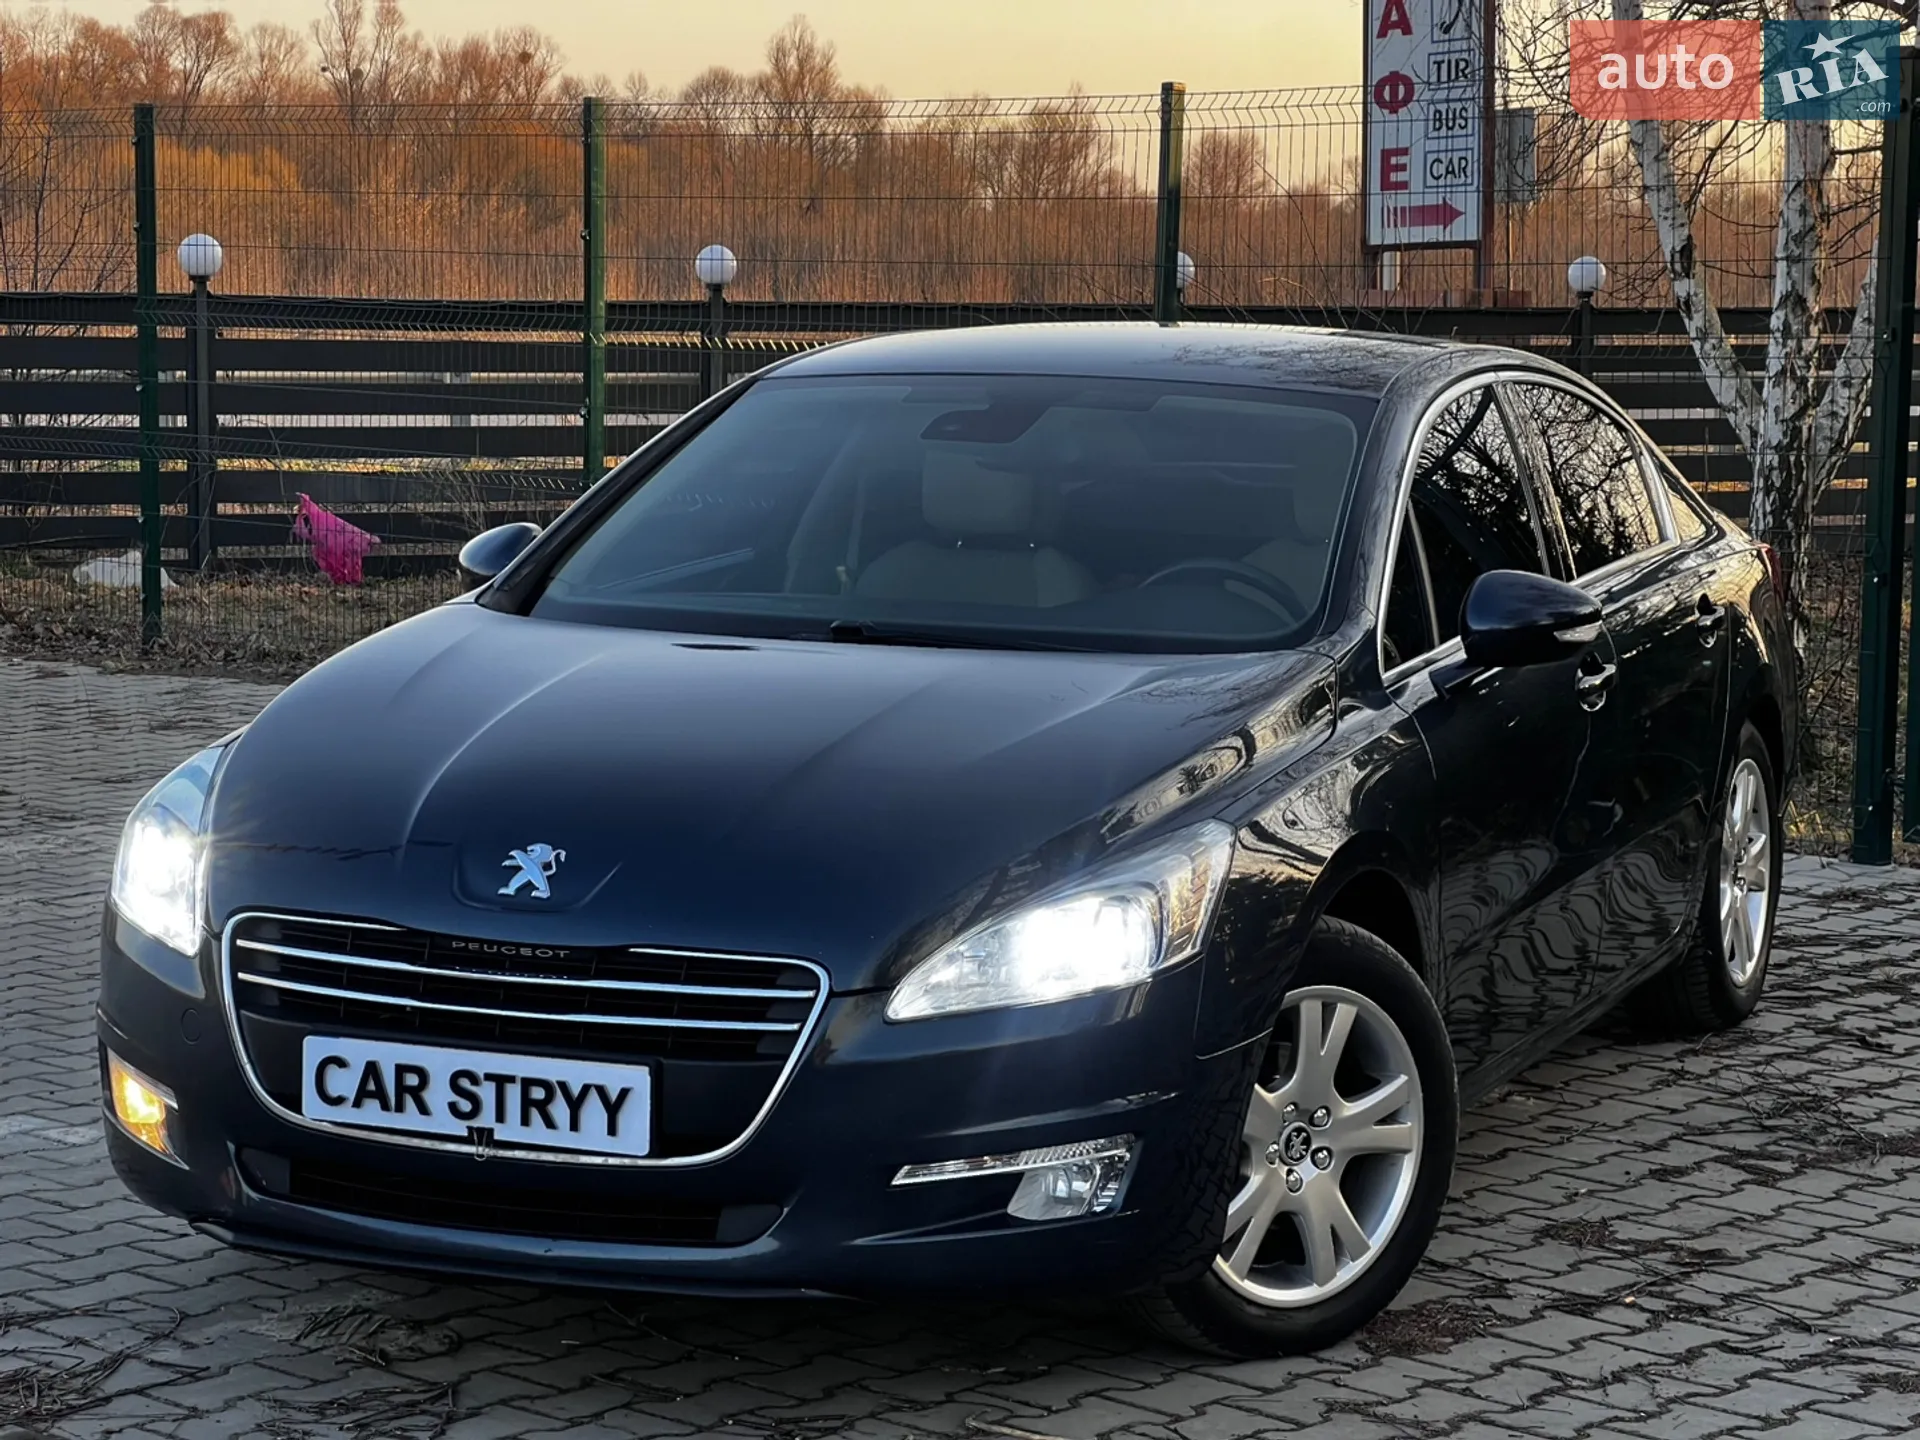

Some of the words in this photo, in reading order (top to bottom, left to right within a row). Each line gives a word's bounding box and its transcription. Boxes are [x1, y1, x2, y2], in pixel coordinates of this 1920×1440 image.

[1433, 58, 1470, 83] TIR
[1432, 106, 1468, 132] BUS
[1429, 156, 1468, 181] CAR
[451, 940, 571, 958] PEUGEOT
[314, 1055, 431, 1116] CAR
[447, 1069, 632, 1136] STRYY
